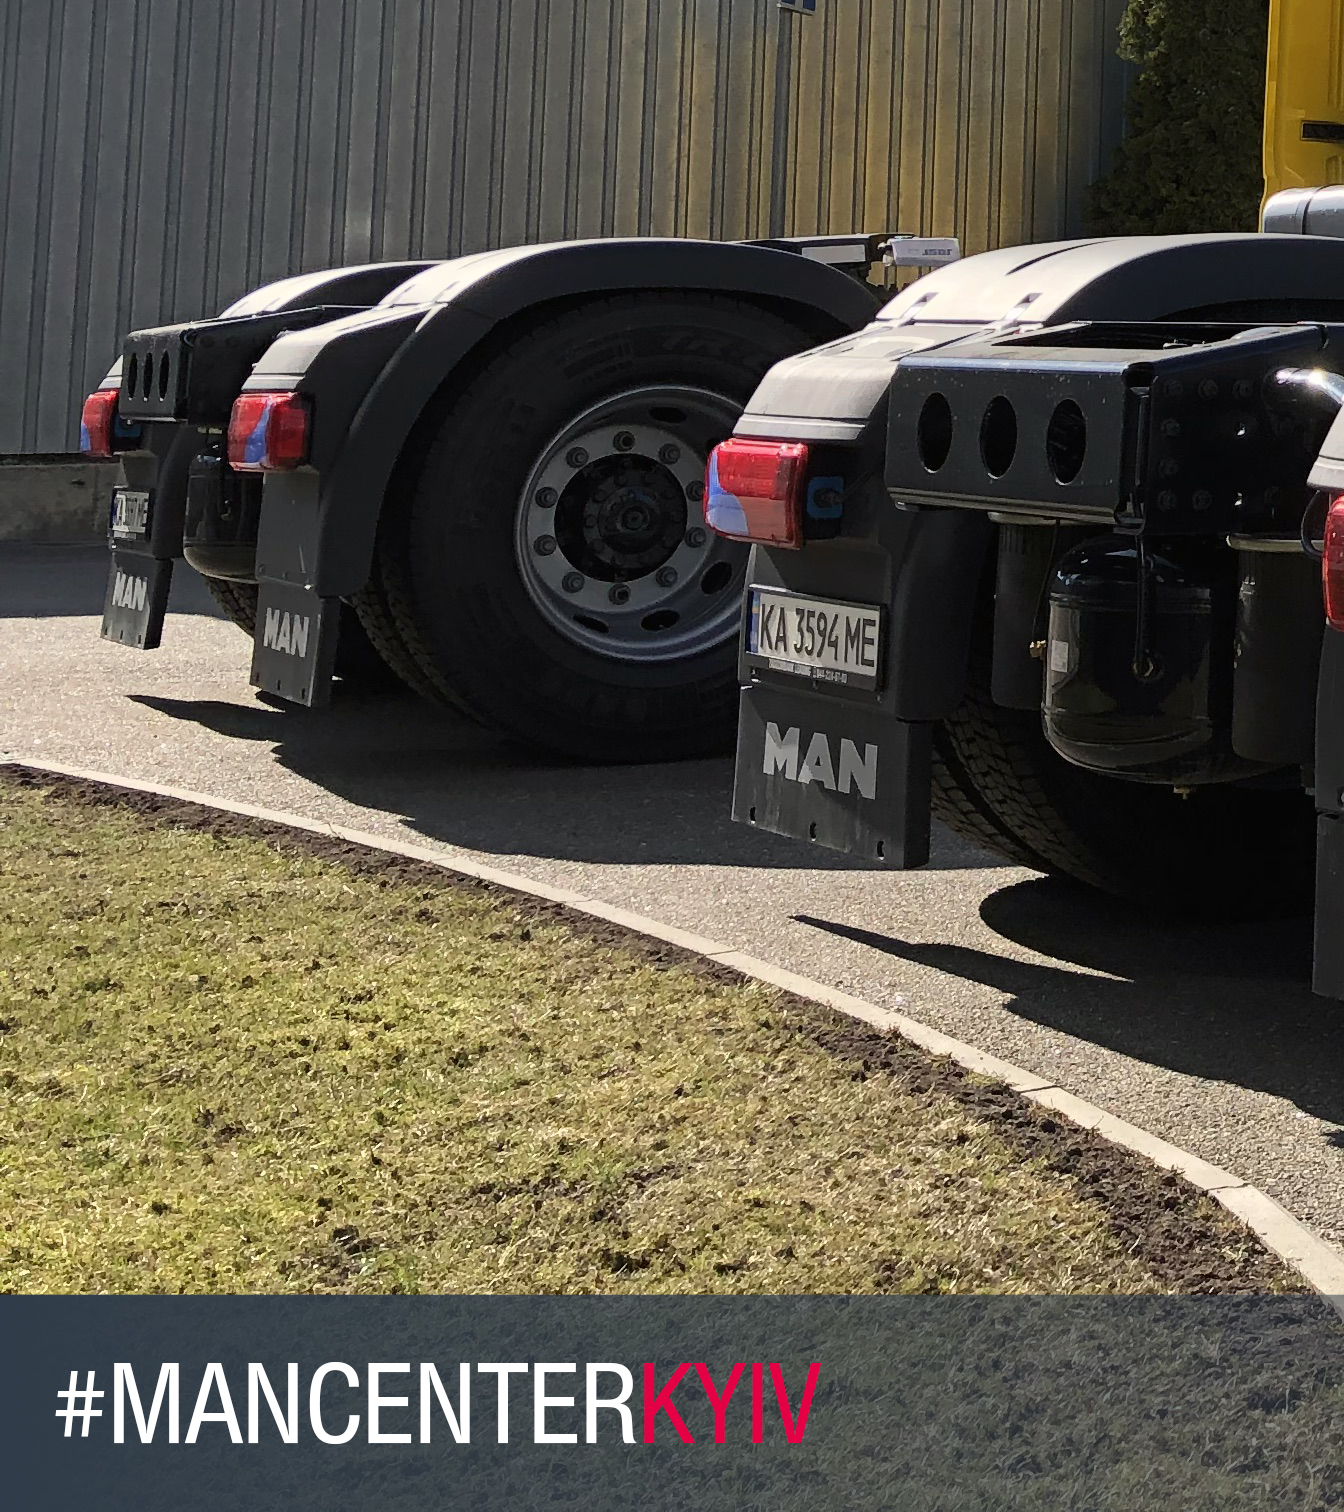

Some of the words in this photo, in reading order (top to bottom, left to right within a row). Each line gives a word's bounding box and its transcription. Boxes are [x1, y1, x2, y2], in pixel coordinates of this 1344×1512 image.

[112, 571, 147, 612] MAN
[263, 607, 310, 658] MAN
[760, 603, 787, 652] KA
[793, 608, 839, 662] 3594
[844, 616, 876, 667] ME
[763, 721, 878, 800] MAN
